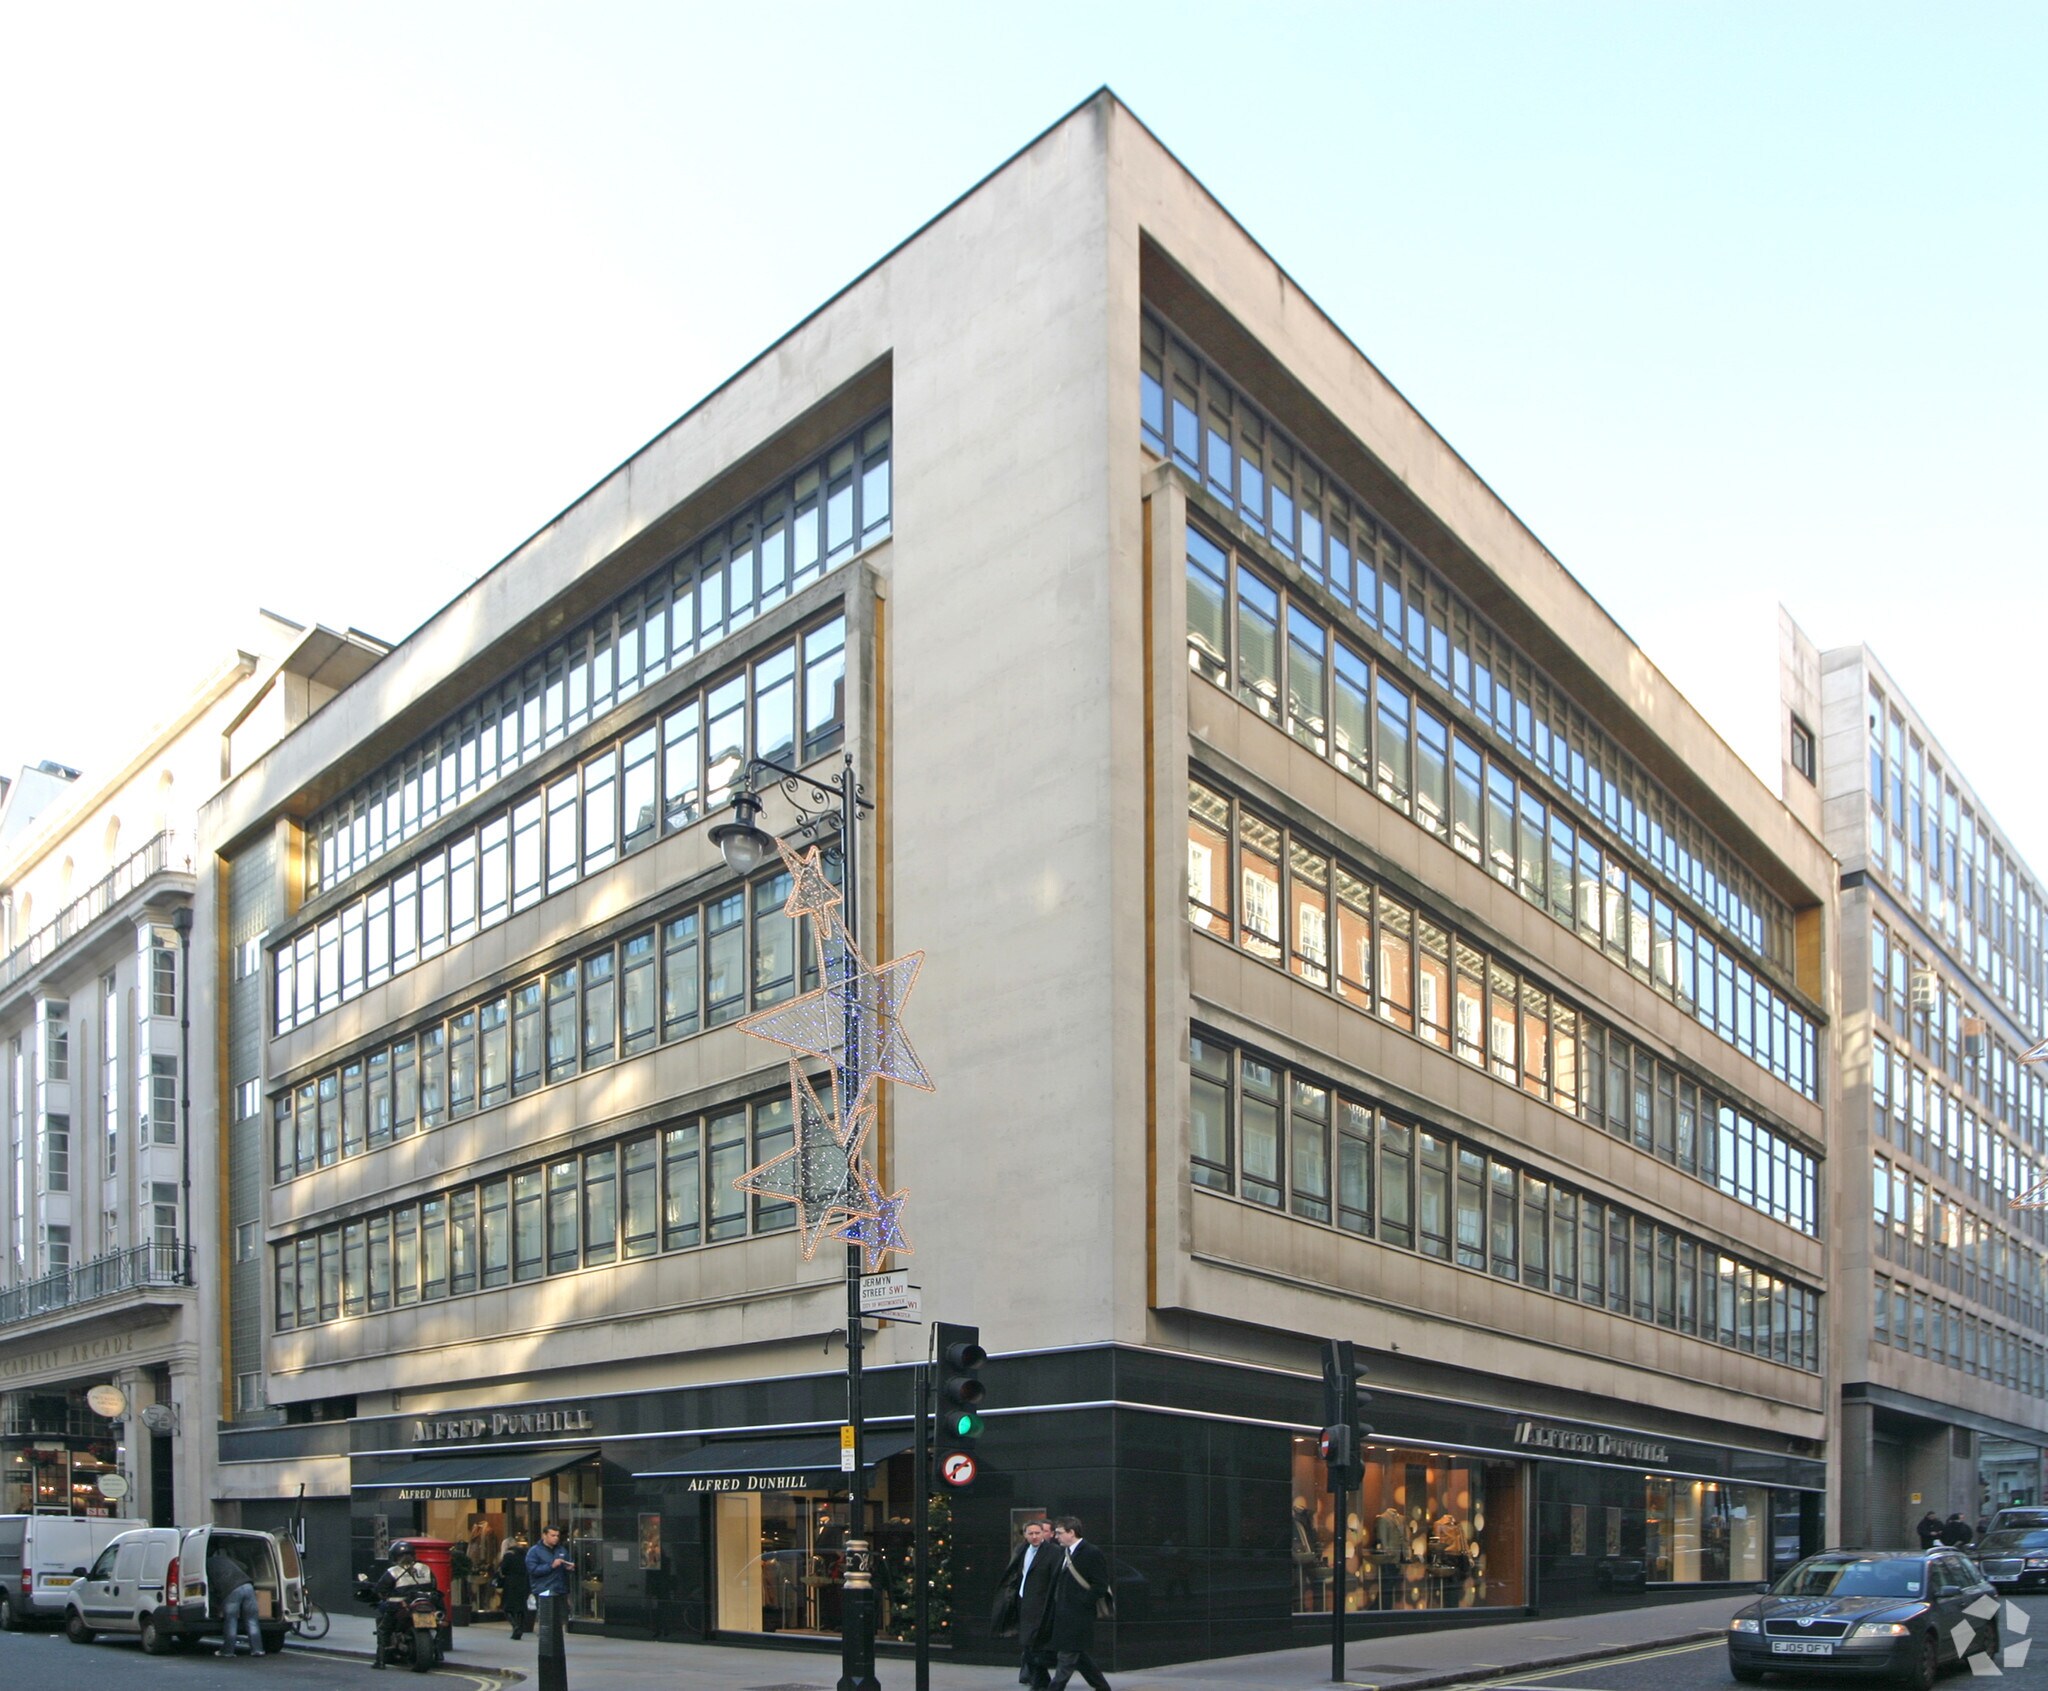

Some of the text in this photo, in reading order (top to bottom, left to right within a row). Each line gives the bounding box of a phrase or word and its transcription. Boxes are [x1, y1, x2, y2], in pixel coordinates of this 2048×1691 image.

[863, 1276, 891, 1287] JERMYN
[862, 1285, 904, 1298] STREET SW1
[907, 1301, 918, 1309] W1
[71, 1333, 133, 1362] ARCADE
[412, 1409, 593, 1442] ALFRED DUNHILL
[1514, 1422, 1669, 1463] ALFRED DUNHILL
[688, 1476, 807, 1491] ALFRED DUNHILL
[399, 1487, 472, 1499] ALFRED DUNHILL
[1774, 1643, 1804, 1653] EJ05
